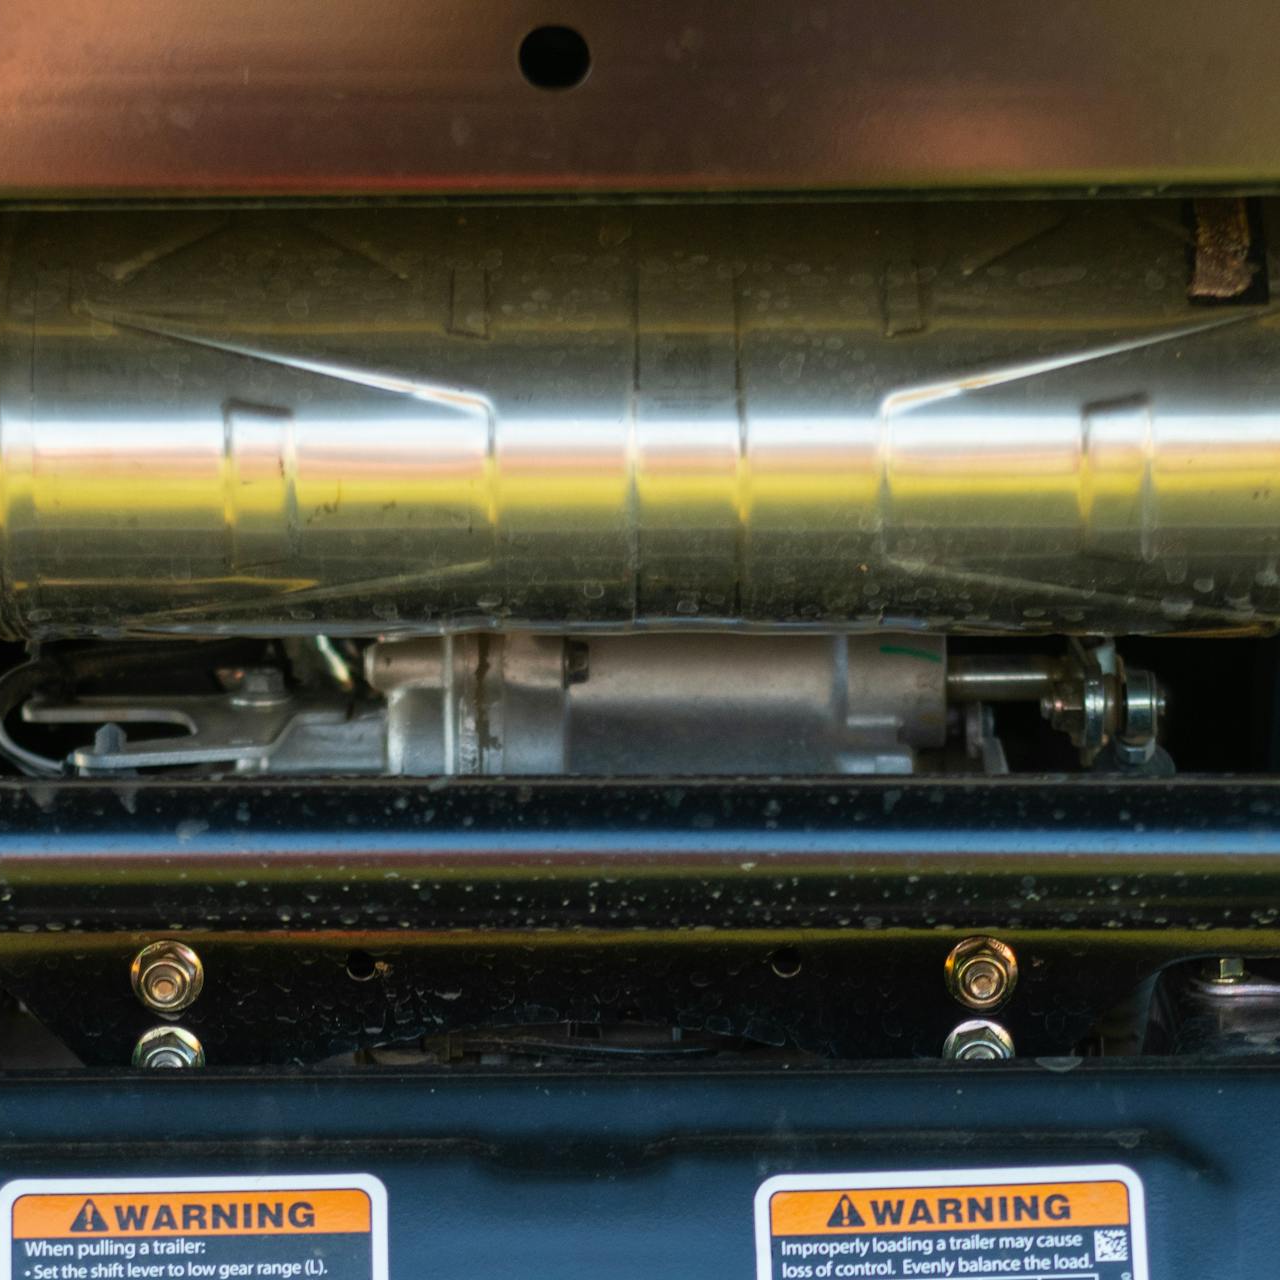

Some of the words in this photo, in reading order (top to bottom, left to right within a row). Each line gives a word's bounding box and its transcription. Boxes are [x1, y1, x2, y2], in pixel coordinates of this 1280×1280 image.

[115, 1202, 314, 1230] WARNING
[871, 1194, 1070, 1225] WARNING
[24, 1240, 74, 1257] When
[77, 1239, 136, 1260] pulling
[139, 1242, 150, 1255] a
[152, 1238, 206, 1255] trailer:
[781, 1238, 870, 1259] Improperly
[872, 1236, 933, 1255] loading
[936, 1239, 946, 1251] a
[949, 1234, 996, 1251] trailer
[999, 1236, 1034, 1252] may
[1036, 1234, 1083, 1248] cause
[33, 1264, 59, 1280] Set
[60, 1263, 88, 1279] the
[90, 1262, 124, 1279] shift
[127, 1262, 165, 1278] lever
[167, 1263, 185, 1277] to
[187, 1261, 216, 1277] low
[218, 1264, 254, 1280] gear
[257, 1263, 302, 1278] range
[304, 1259, 328, 1276] (L).
[782, 1262, 813, 1278] loss
[815, 1260, 833, 1277] of
[835, 1259, 896, 1277] control.
[902, 1257, 956, 1277] Evenly
[958, 1256, 1021, 1273] balance
[1023, 1254, 1051, 1271] the
[1054, 1252, 1094, 1270] load.
